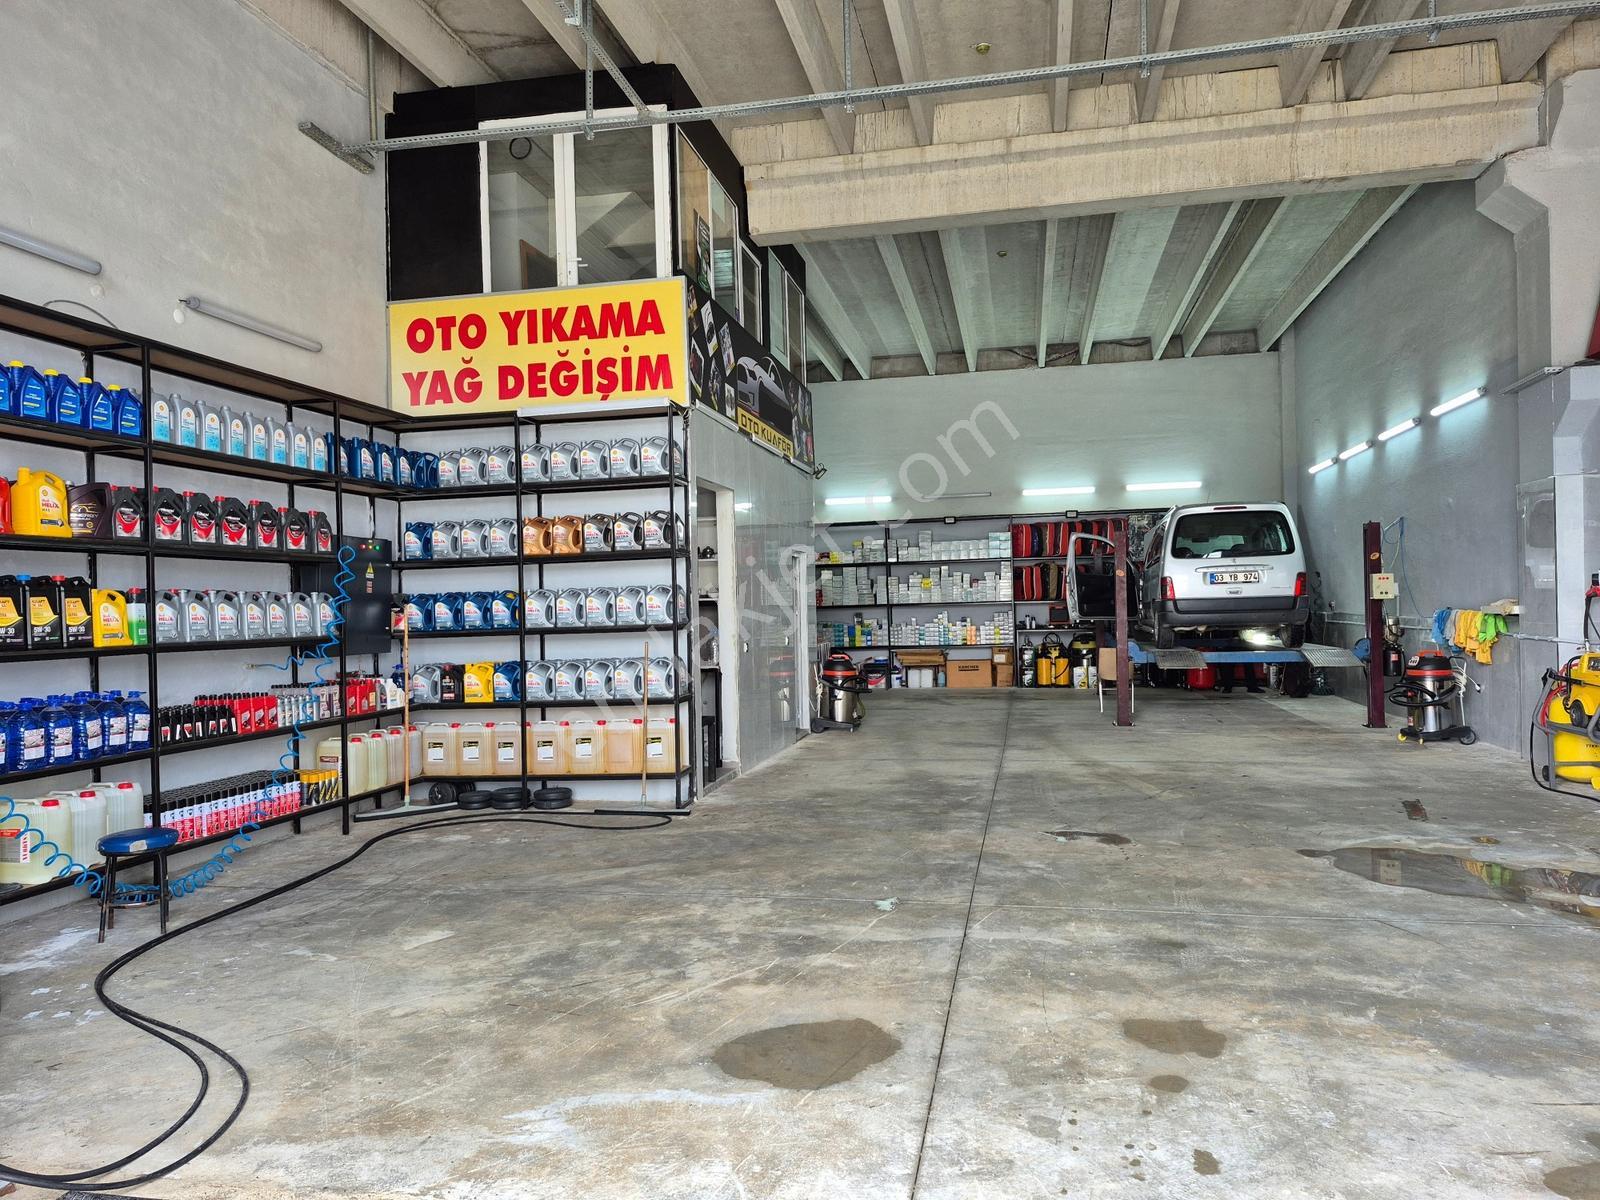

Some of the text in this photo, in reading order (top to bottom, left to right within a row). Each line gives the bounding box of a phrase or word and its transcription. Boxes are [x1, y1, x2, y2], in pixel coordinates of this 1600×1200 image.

[406, 299, 666, 354] OTO YIKAMA
[402, 344, 674, 406] YAĞ DEĞİŞİM
[741, 413, 760, 435] OTO
[1214, 574, 1225, 582] 03
